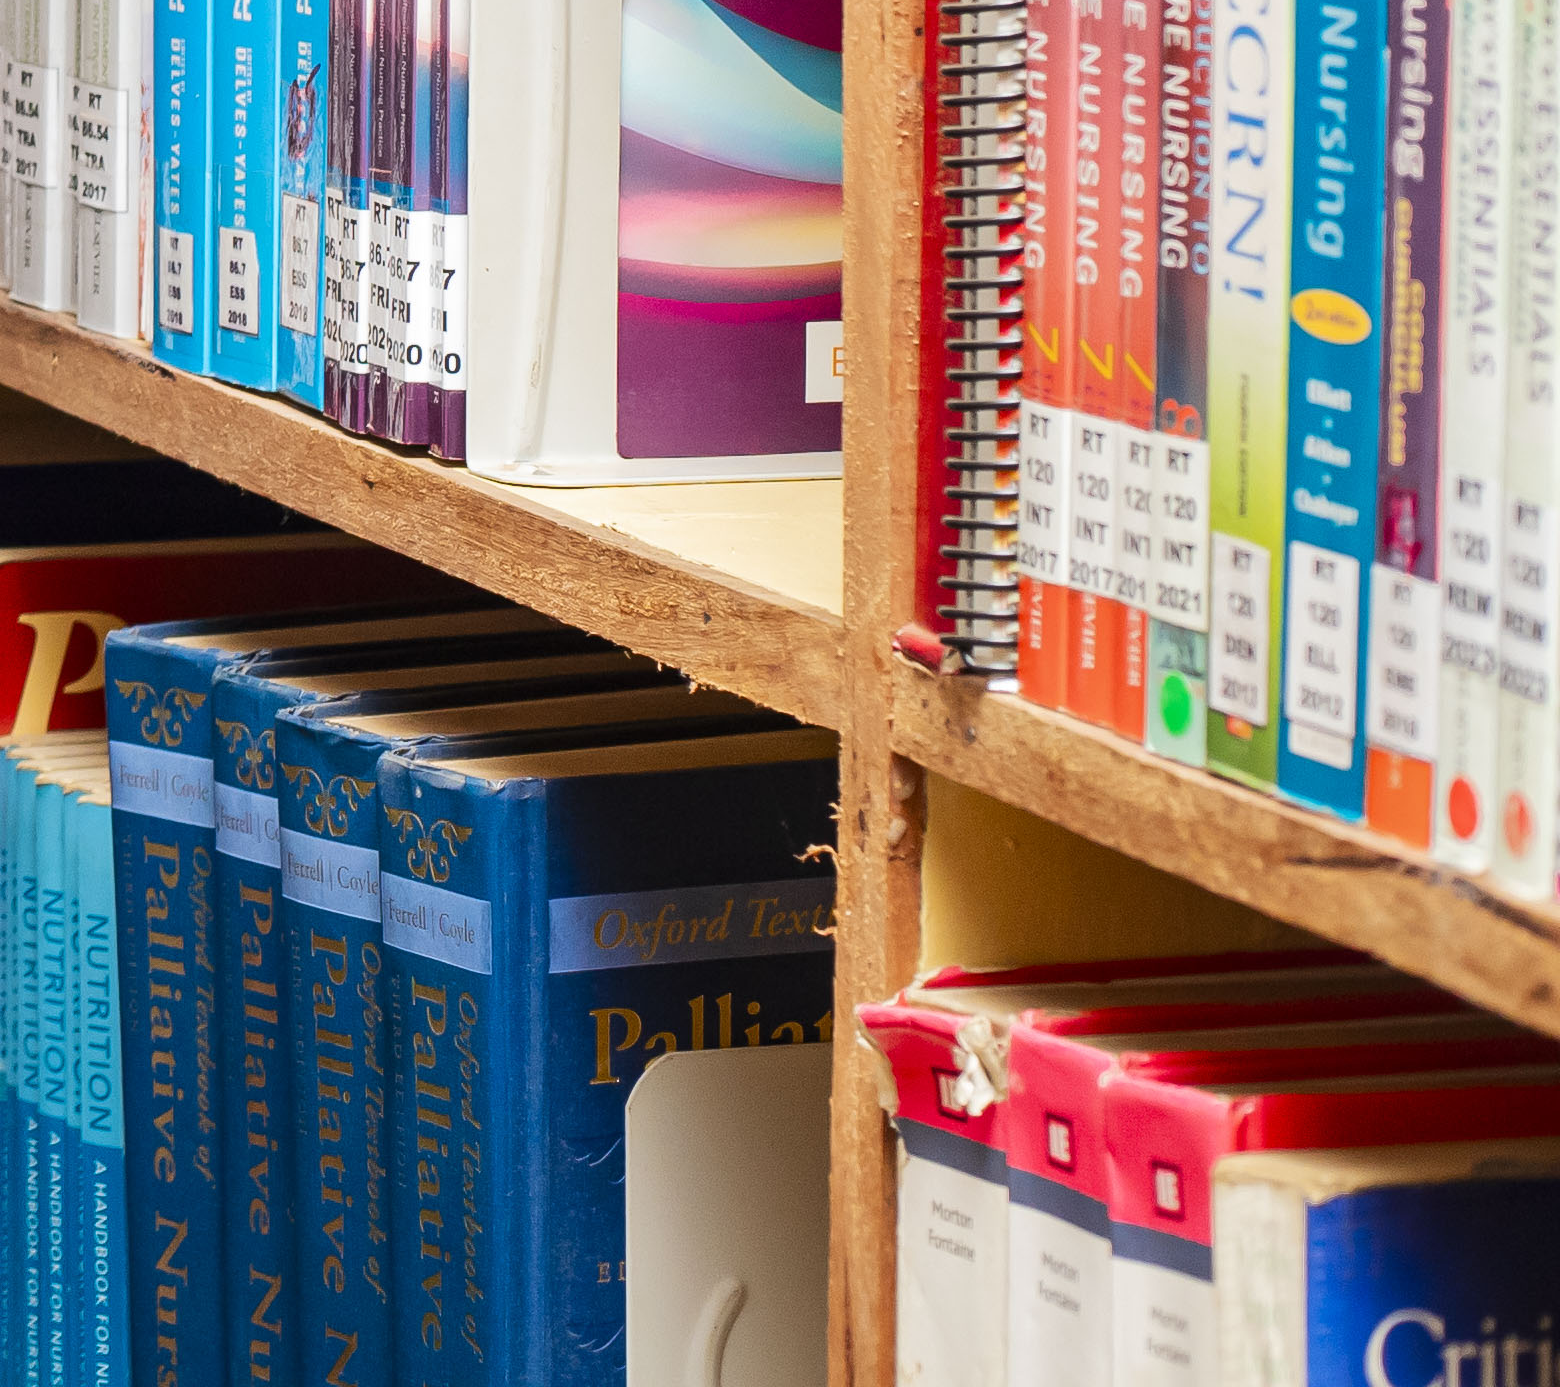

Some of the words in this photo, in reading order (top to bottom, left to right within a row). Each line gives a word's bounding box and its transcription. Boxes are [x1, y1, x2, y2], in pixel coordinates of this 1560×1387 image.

[233, 47, 246, 227] DELVES-YATES
[1305, 5, 1358, 259] Nursing
[1075, 43, 1102, 286] NURSING
[1160, 64, 1190, 270] NURSING
[232, 237, 244, 250] RT
[229, 260, 247, 276] 86.7
[229, 286, 246, 302] ESS
[227, 309, 247, 327] 2018
[1168, 448, 1192, 475] RT
[1163, 492, 1197, 522] 120
[1163, 539, 1195, 567] INT
[1156, 584, 1202, 613] 2021
[389, 899, 428, 931] Ferrell
[438, 915, 476, 946] Coyle
[594, 899, 734, 960] Oxford
[85, 914, 112, 1133] NUTRITION
[456, 991, 480, 1132] Oxford
[93, 1160, 107, 1174] A
[411, 978, 452, 1353] Palliative
[94, 1182, 109, 1307] HANDBOOK
[95, 1314, 109, 1355] FOR
